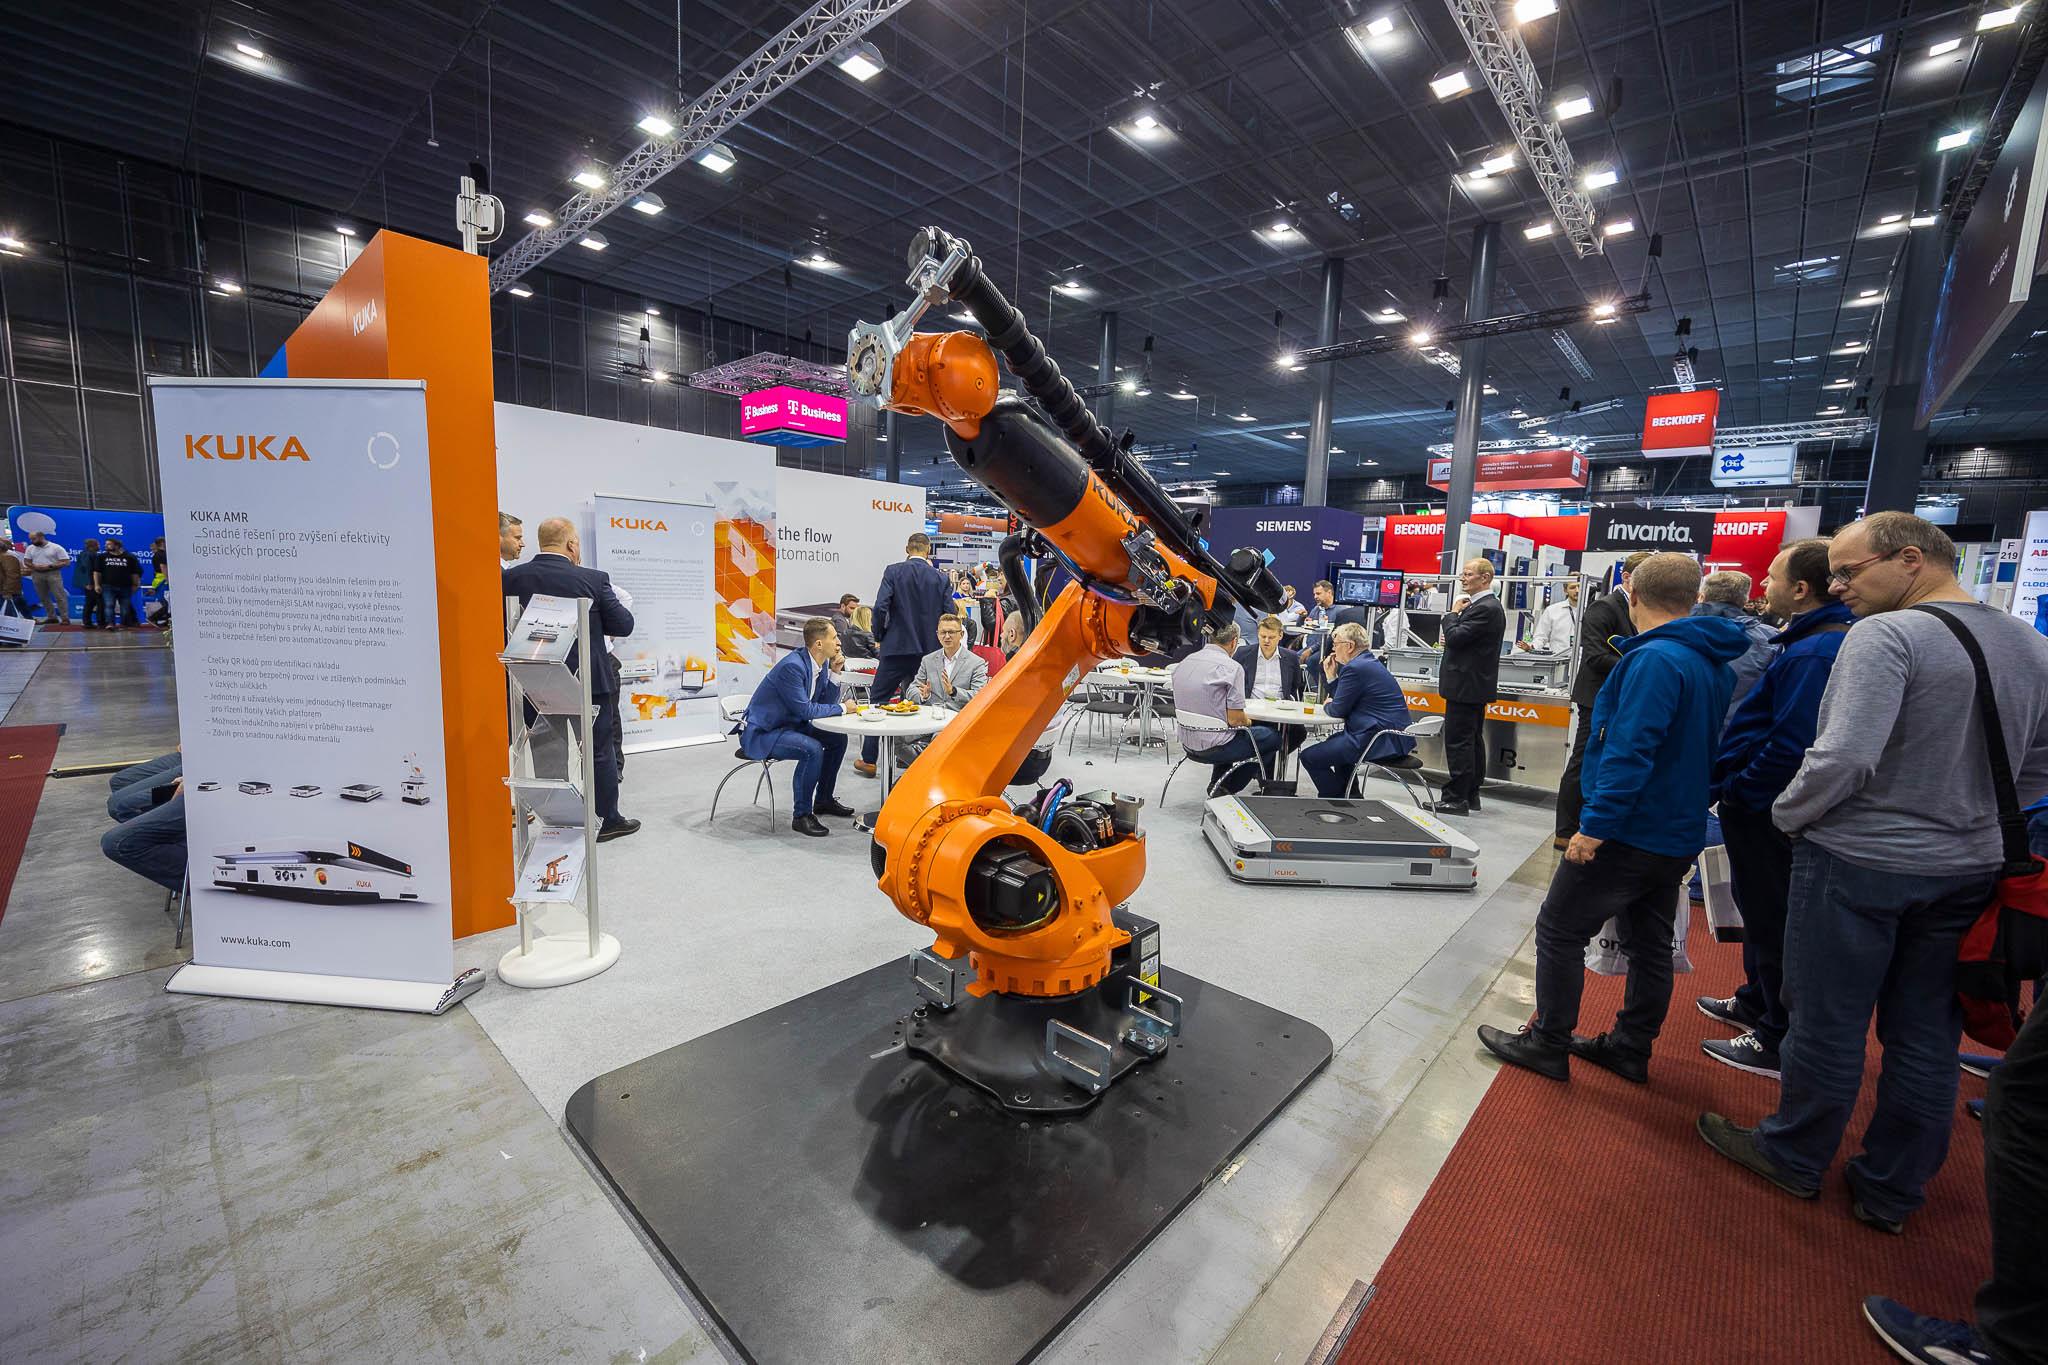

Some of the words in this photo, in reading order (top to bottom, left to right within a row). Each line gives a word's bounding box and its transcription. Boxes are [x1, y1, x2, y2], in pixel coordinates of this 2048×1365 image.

[353, 298, 378, 336] KUKA
[752, 404, 778, 417] Business
[801, 404, 842, 422] Business
[1652, 414, 1705, 427] BECKHOFF
[185, 434, 311, 461] KUKA
[872, 499, 914, 514] KUKA
[1091, 478, 1140, 534] KUKA
[190, 511, 221, 522] KUKA
[223, 512, 249, 523] AMR
[610, 517, 670, 532] KUKA
[1256, 520, 1312, 532] SIEMENS
[98, 527, 123, 536] 602
[243, 528, 275, 541] řešení
[278, 532, 296, 544] pro
[299, 531, 337, 545] zvýšení
[340, 531, 391, 546] efektivity
[777, 526, 801, 542] the
[804, 528, 833, 544] flow
[192, 544, 254, 558] logistických
[257, 546, 298, 559] procesů
[2007, 541, 2016, 550] F
[2000, 552, 2019, 560] 219
[2031, 549, 2048, 557] AB
[294, 600, 314, 608] SLAM
[369, 627, 385, 635] AMR
[231, 657, 241, 665] QR
[1487, 704, 1539, 719] KUKA
[221, 935, 291, 949] www.kuka.com
